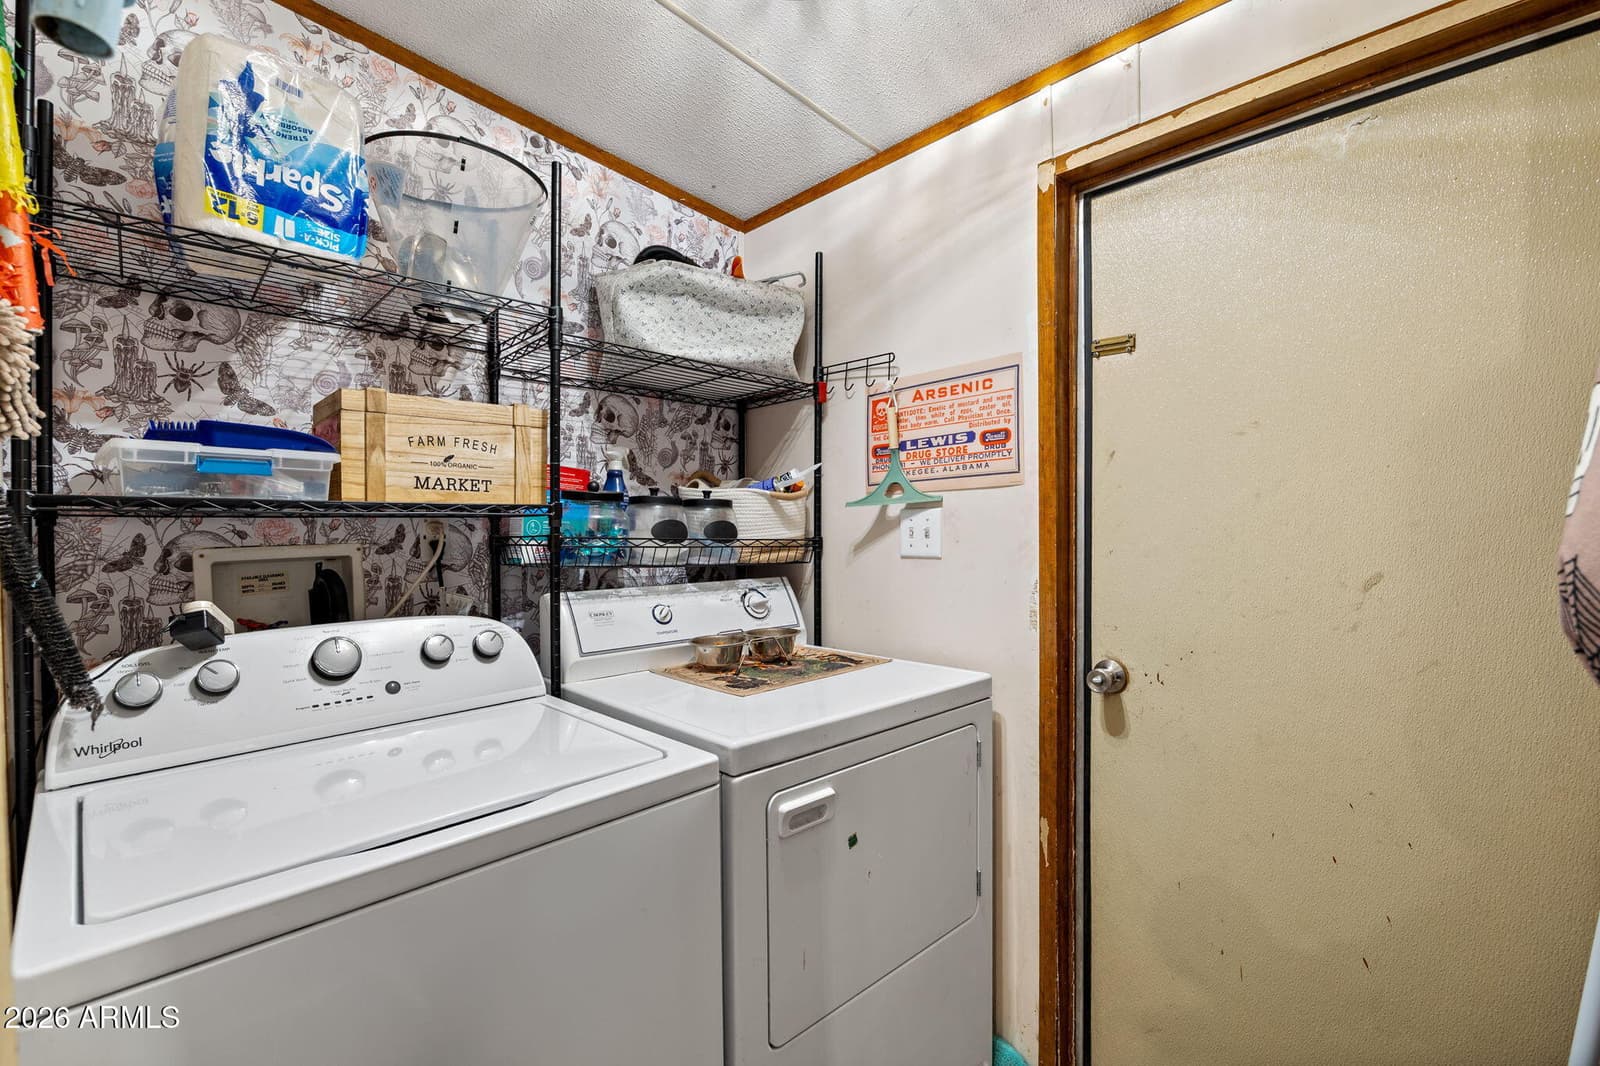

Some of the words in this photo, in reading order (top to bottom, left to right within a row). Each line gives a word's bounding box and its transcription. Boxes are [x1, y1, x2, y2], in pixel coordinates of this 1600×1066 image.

[260, 112, 314, 135] ABSORBY
[264, 124, 309, 142] STRENG
[209, 141, 345, 213] Sparkle
[211, 193, 241, 220] 12
[912, 378, 993, 402] ARSENIC
[968, 419, 1001, 429] Distributed
[407, 436, 446, 448] FARM
[454, 437, 498, 454] FRESH
[905, 433, 968, 449] LEWIS
[906, 449, 932, 460] DRUG
[936, 445, 969, 457] STORE
[934, 454, 965, 464] DELIVER
[968, 450, 1012, 460] PROMPTLY
[430, 460, 447, 468] 100%
[447, 462, 478, 470] ORGANIC
[904, 467, 939, 476] KEGEE,
[943, 462, 990, 472] ALABAMA
[414, 476, 492, 493] MARKET
[74, 737, 142, 758] Whirlpool
